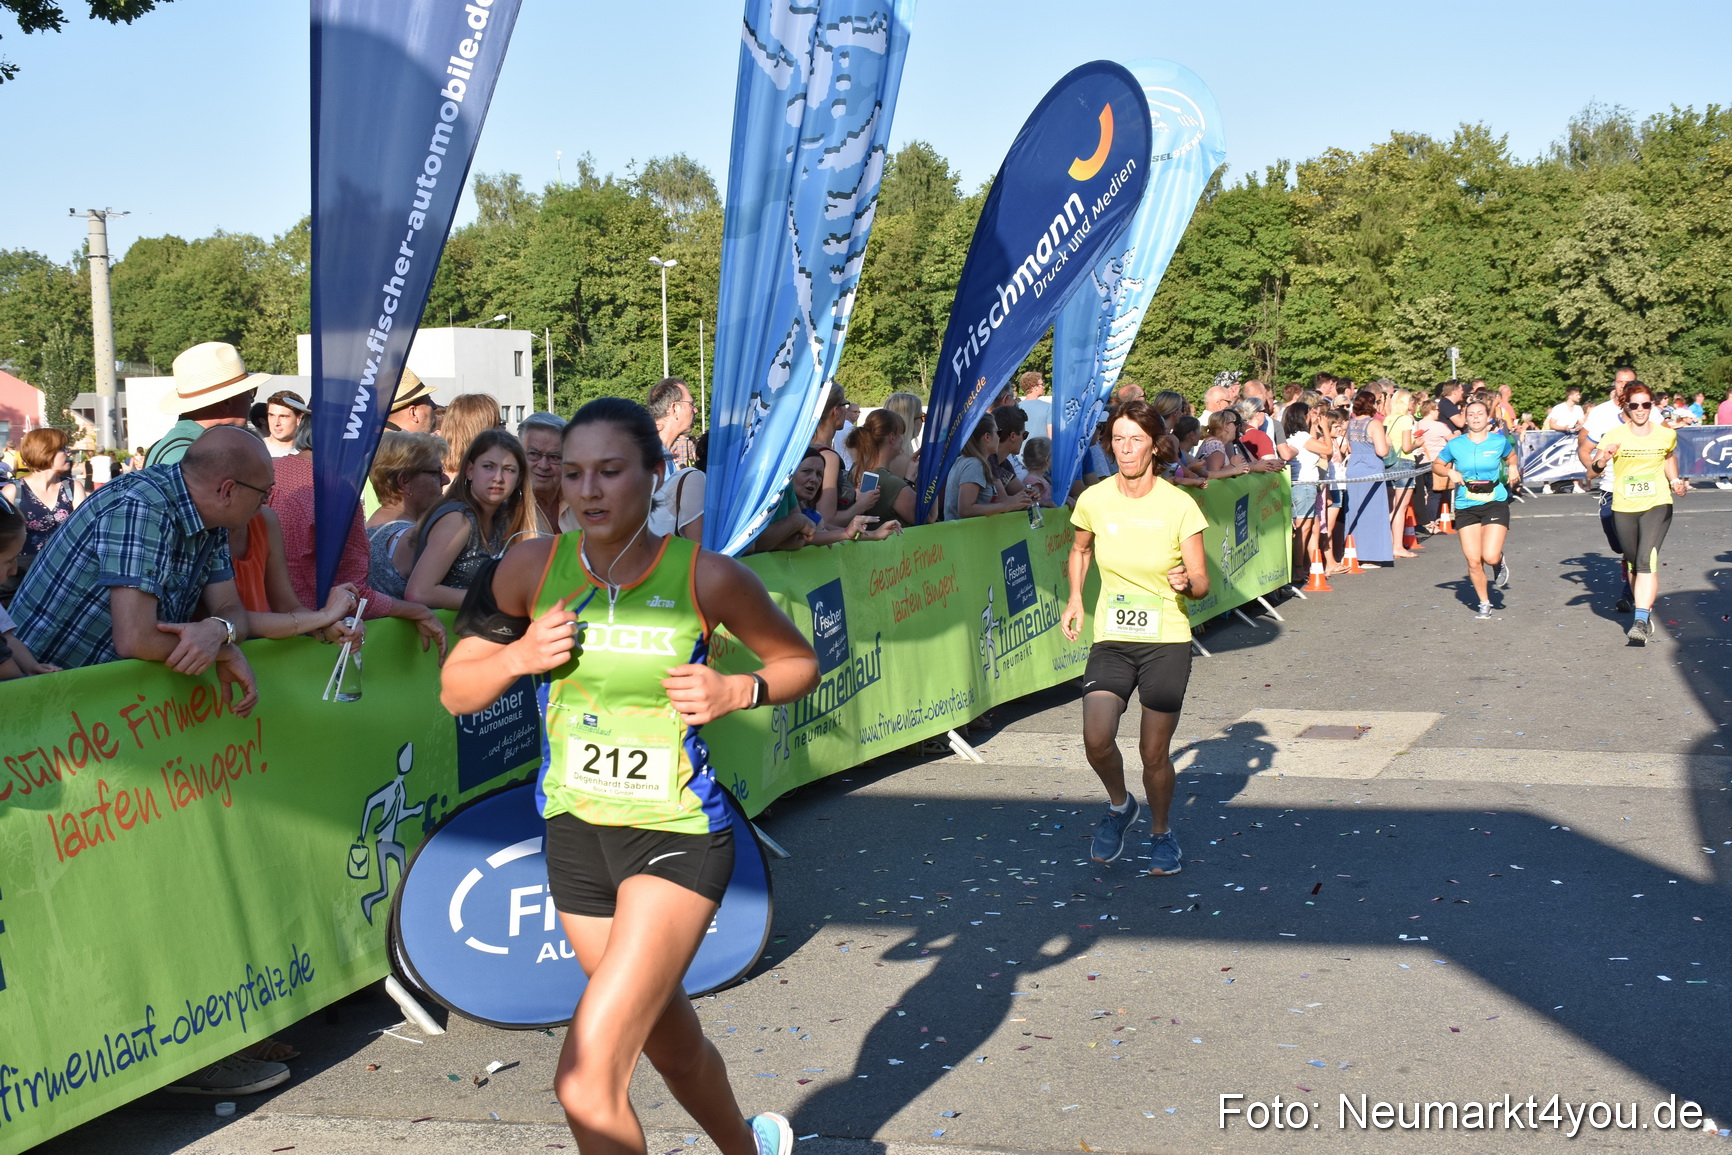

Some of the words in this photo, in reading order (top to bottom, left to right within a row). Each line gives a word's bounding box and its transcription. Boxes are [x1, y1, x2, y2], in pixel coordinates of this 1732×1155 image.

[1033, 252, 1069, 299] Druck
[1067, 216, 1091, 252] und
[1092, 158, 1137, 220] Medien
[951, 192, 1085, 385] Frischmann
[1630, 482, 1650, 492] 738
[819, 608, 842, 632] Fischer
[891, 586, 923, 624] laufen
[999, 584, 1061, 653] firmenlauf
[1116, 609, 1148, 627] 928
[575, 621, 678, 656] OCK
[1002, 645, 1033, 671] neumarkt
[472, 690, 524, 727] Fischer
[478, 710, 523, 737] AUTOMOBILE
[0, 710, 120, 801] sunde
[119, 684, 237, 749] Firmen
[794, 711, 842, 750] neumarkt
[582, 743, 648, 780] 212
[47, 779, 162, 863] laufen
[161, 718, 268, 812] länger!
[573, 771, 622, 789] Degenhardt
[624, 781, 660, 791] Sabrina
